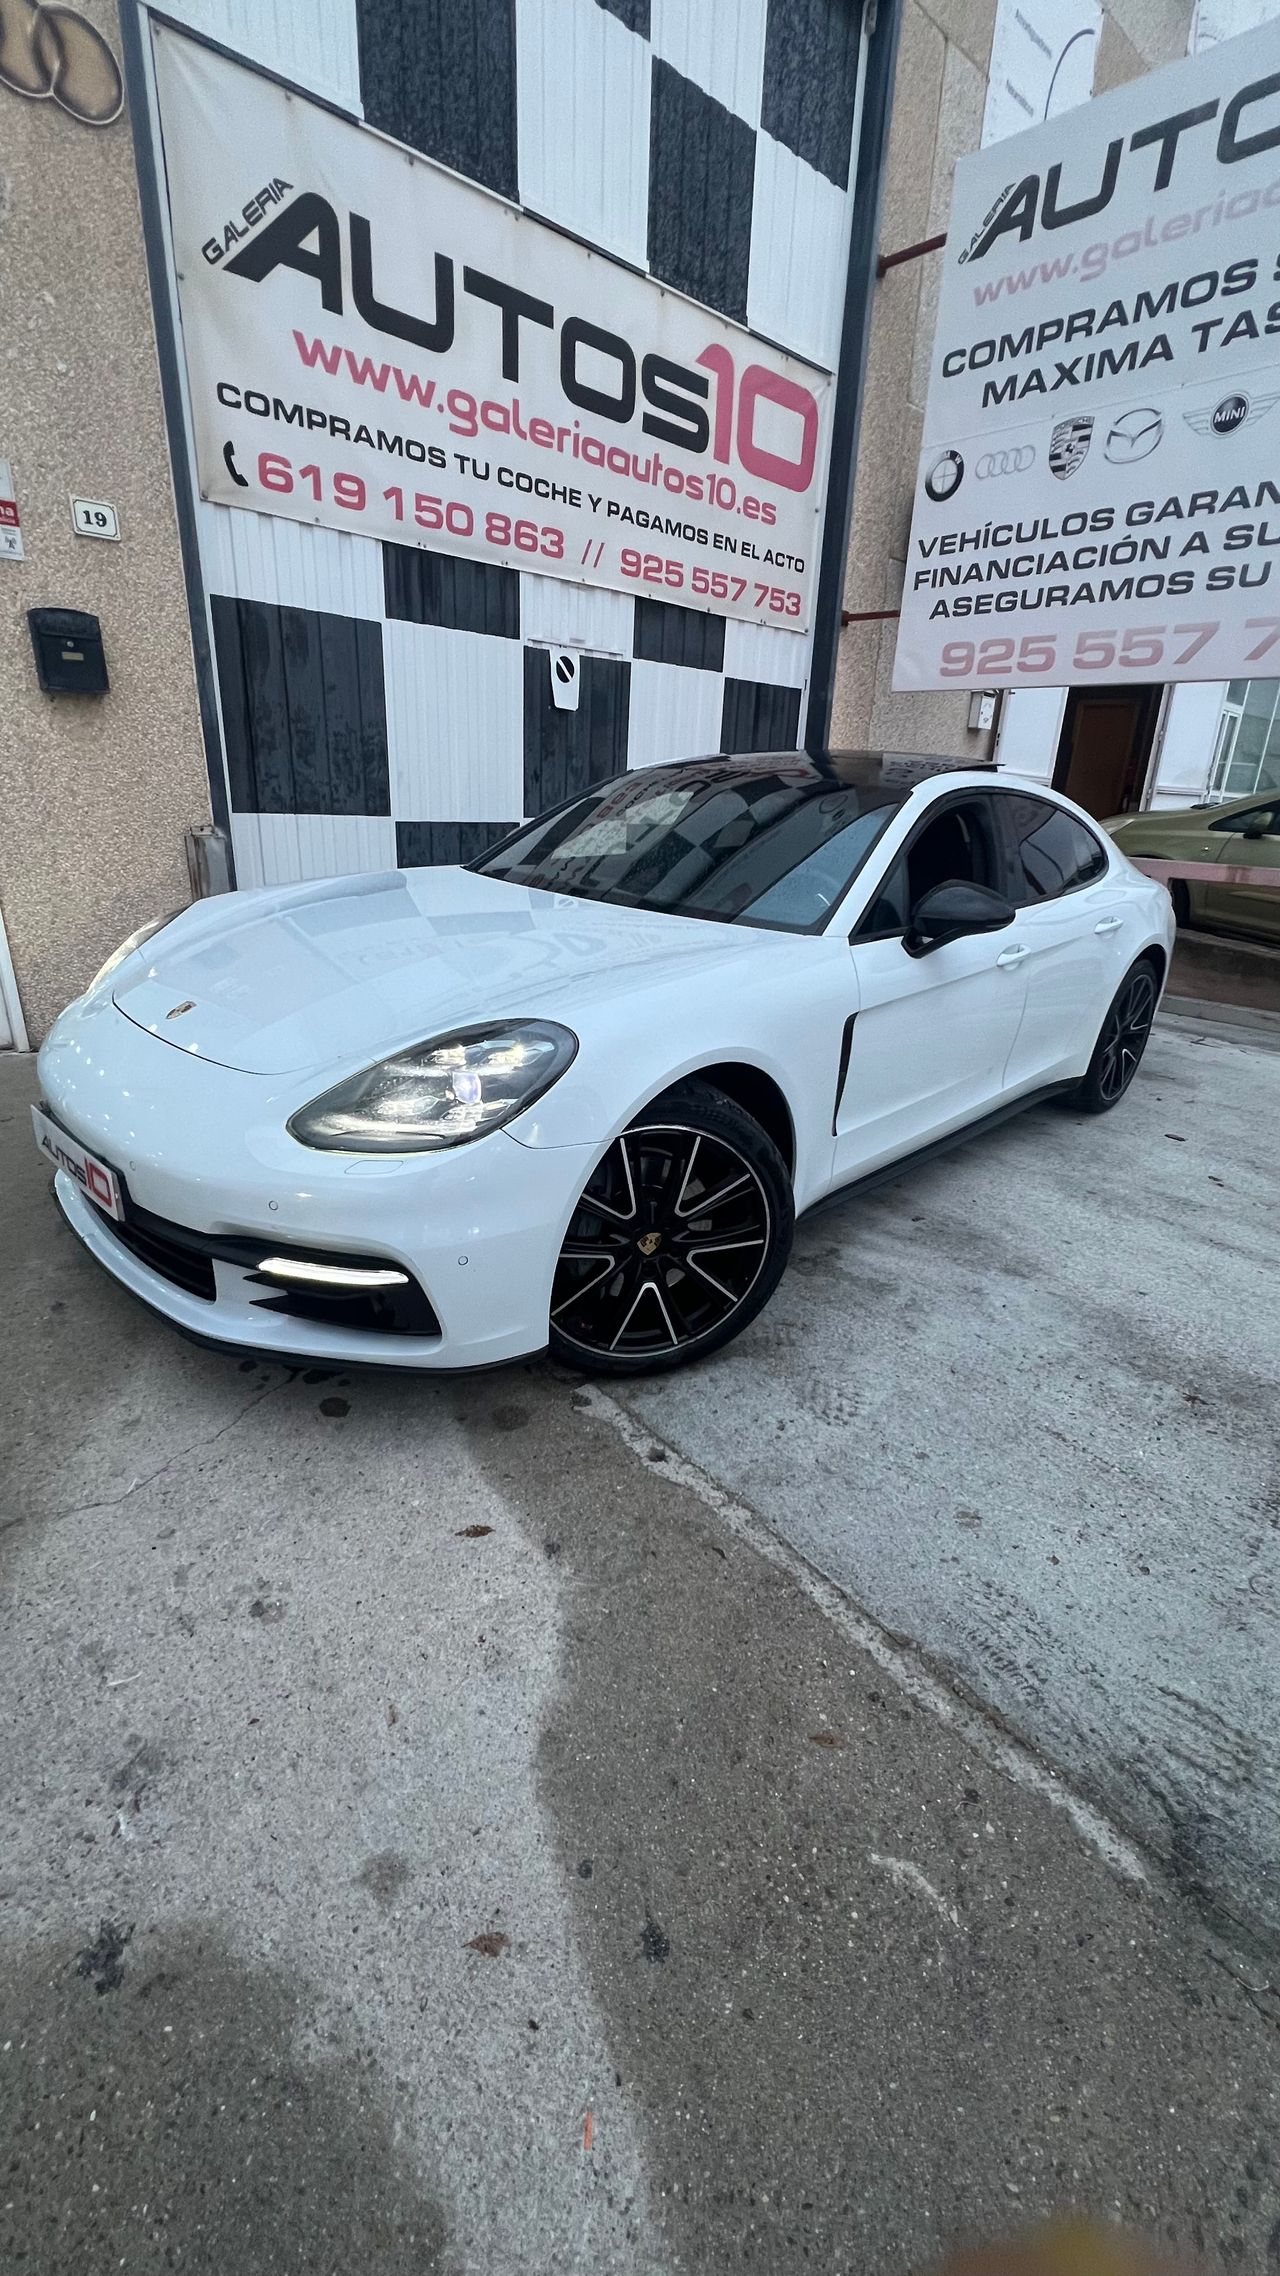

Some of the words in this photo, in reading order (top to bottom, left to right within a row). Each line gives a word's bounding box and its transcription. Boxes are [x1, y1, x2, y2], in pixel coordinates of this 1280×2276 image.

[201, 177, 294, 265] GALERIA
[958, 183, 1016, 264] GALERIA
[222, 191, 819, 493] AUTOS10
[942, 258, 1258, 378] COMPRAMOS
[981, 333, 1174, 408] MAXIMA
[292, 329, 777, 526] www.galeriaautos10.es
[1214, 406, 1246, 424] MINI
[216, 382, 447, 468] COMPRAMOS
[454, 453, 490, 480] TU
[497, 466, 582, 508] COCHE
[588, 494, 602, 513] Y
[607, 500, 709, 546] PAGAMOS
[713, 533, 738, 554] EN
[741, 541, 760, 560] EL
[763, 548, 805, 573] ACTO
[82, 509, 108, 528] 19
[257, 452, 366, 511] 619
[383, 486, 474, 537] 150
[485, 511, 564, 559] 863
[620, 548, 684, 587] 925
[691, 565, 747, 602] 557
[753, 582, 801, 616] 753
[918, 507, 1115, 559] VEHÍCULOS
[913, 534, 1171, 591] FINANCIACIÓN
[1179, 530, 1210, 557] A
[929, 571, 1195, 620] ASEGURAMOS
[1206, 561, 1272, 591] SU
[939, 634, 1057, 677] 925
[1072, 621, 1220, 670] 557
[42, 1135, 112, 1208] AUTOS10
